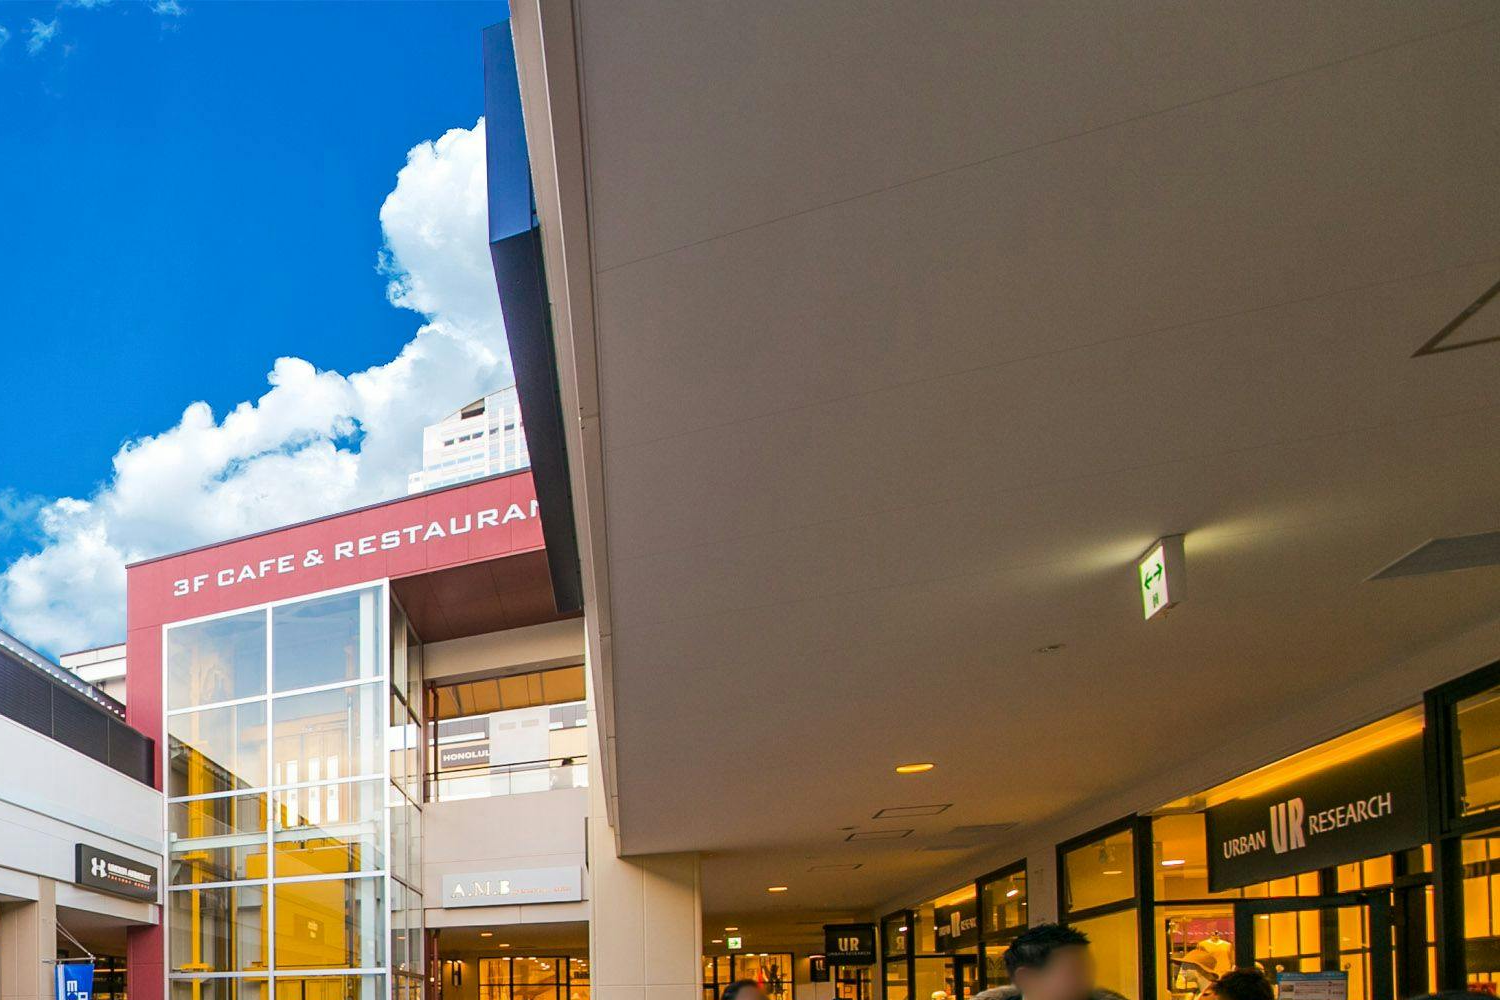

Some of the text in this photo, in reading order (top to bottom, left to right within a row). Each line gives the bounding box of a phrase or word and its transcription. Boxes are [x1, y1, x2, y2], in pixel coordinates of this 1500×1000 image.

[173, 574, 209, 597] 3F
[216, 554, 295, 587] CAFE
[303, 548, 325, 568] &
[1223, 792, 1393, 859] URBAN UR RESEARCH
[838, 937, 860, 952] UR
